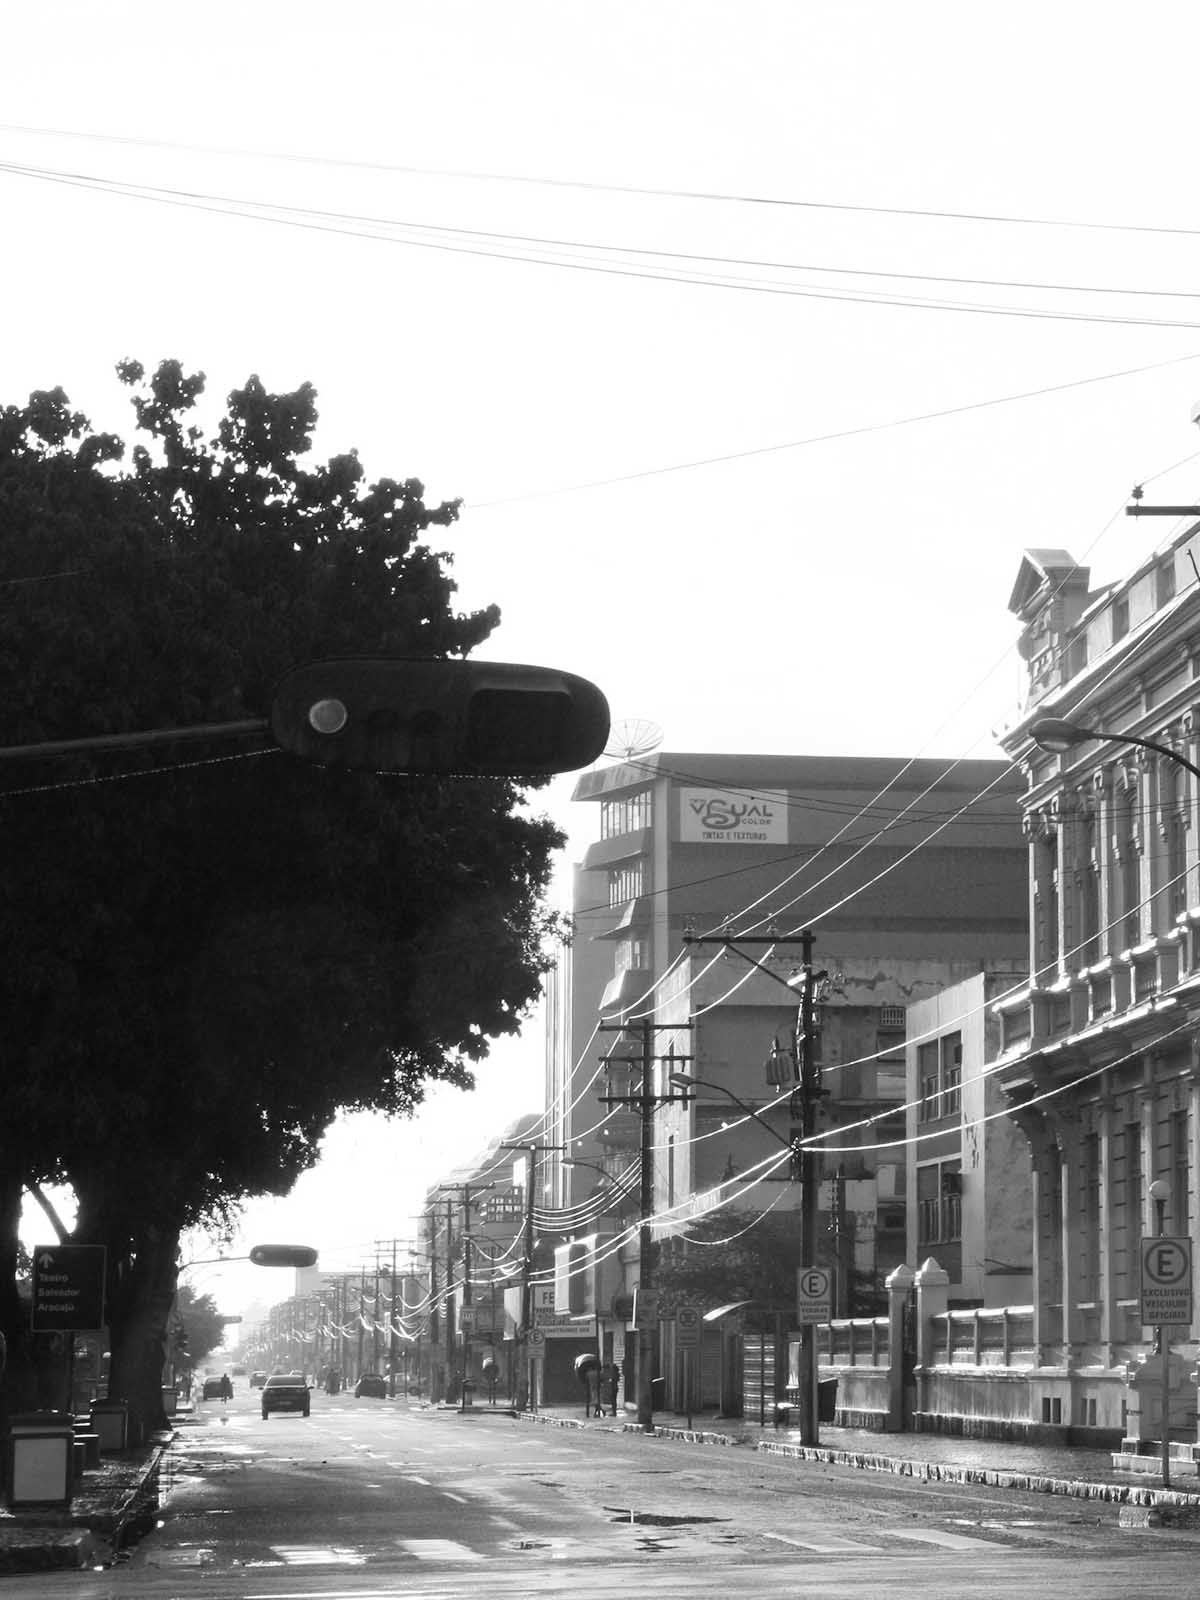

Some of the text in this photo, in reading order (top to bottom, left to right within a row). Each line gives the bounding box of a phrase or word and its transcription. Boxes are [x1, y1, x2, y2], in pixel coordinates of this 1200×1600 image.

[1158, 1249, 1174, 1276] E
[37, 1287, 81, 1297] Salvador
[808, 1275, 819, 1293] E
